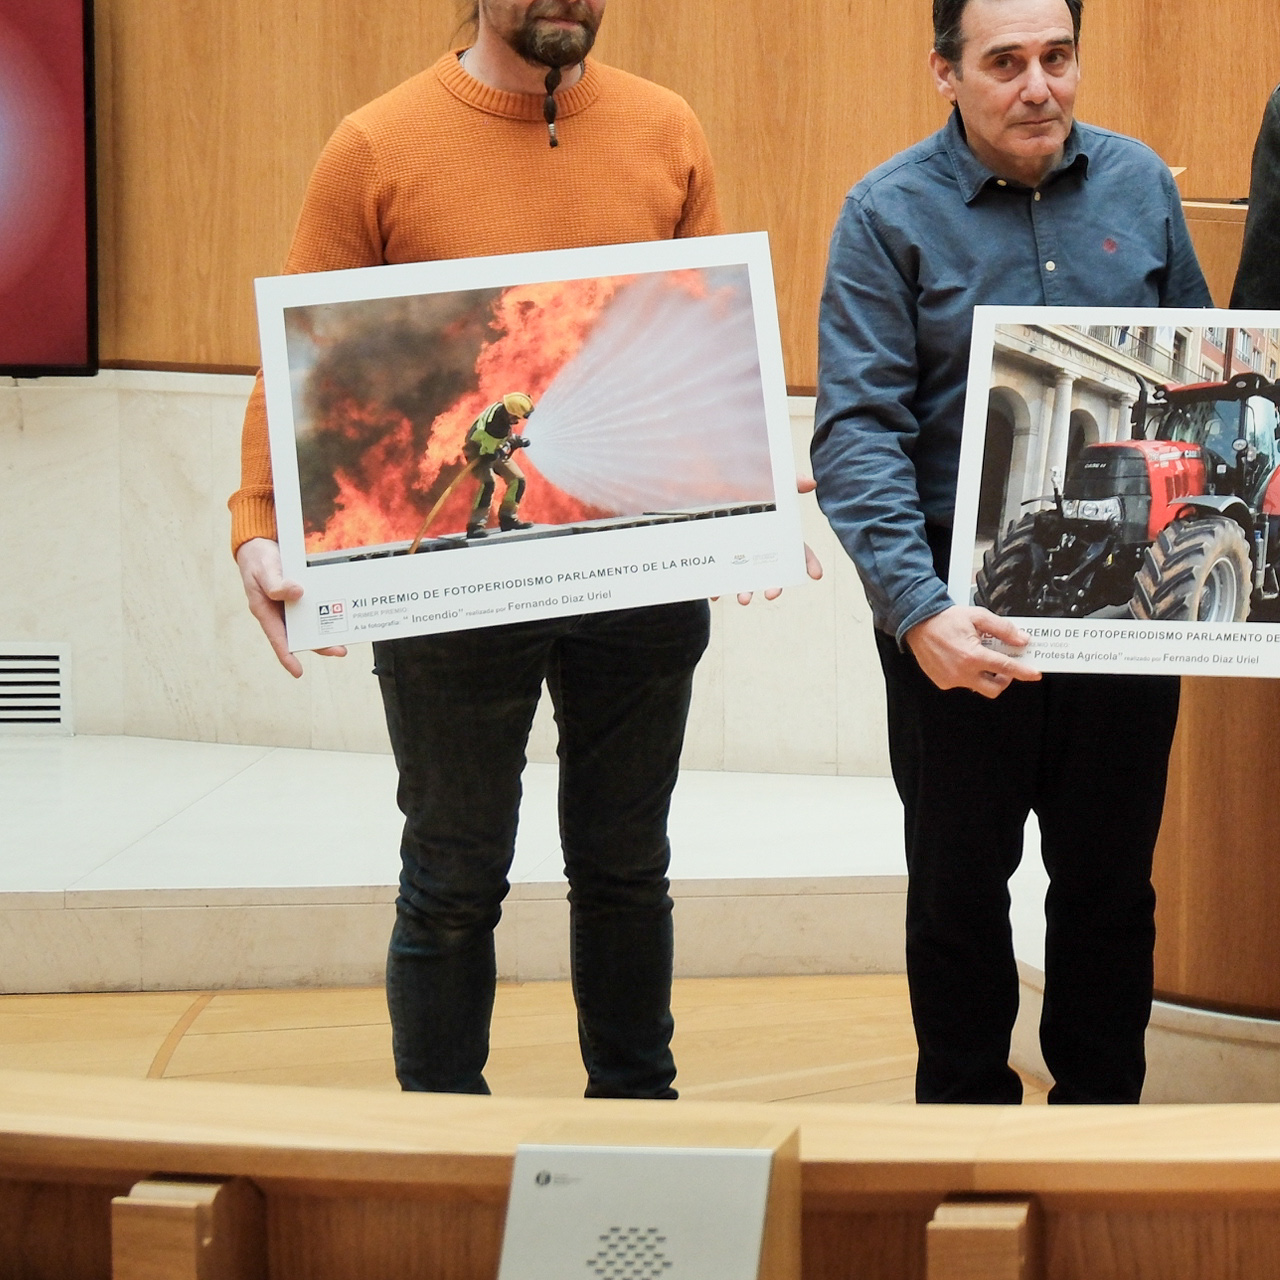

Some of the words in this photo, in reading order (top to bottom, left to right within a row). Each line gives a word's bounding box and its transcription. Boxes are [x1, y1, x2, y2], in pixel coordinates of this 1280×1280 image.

[352, 599, 367, 608] XII
[372, 592, 418, 606] PREMIO
[424, 589, 440, 599] DE
[444, 576, 553, 596] FOTOPERIODISMO
[557, 565, 638, 582] PARLAMENTO
[643, 562, 658, 572] DE
[662, 560, 678, 570] LA
[681, 556, 716, 567] RIOJA
[508, 597, 558, 610] Fernando
[587, 590, 612, 600] Uriel
[1065, 629, 1080, 638] DE
[1084, 630, 1183, 640] FOTOPERIODISMO
[1187, 632, 1262, 642] PARLAMENTO
[1266, 634, 1280, 642] DE
[1034, 650, 1074, 659] Protesta
[1163, 653, 1209, 663] Fernando
[1236, 655, 1259, 664] Uriel
